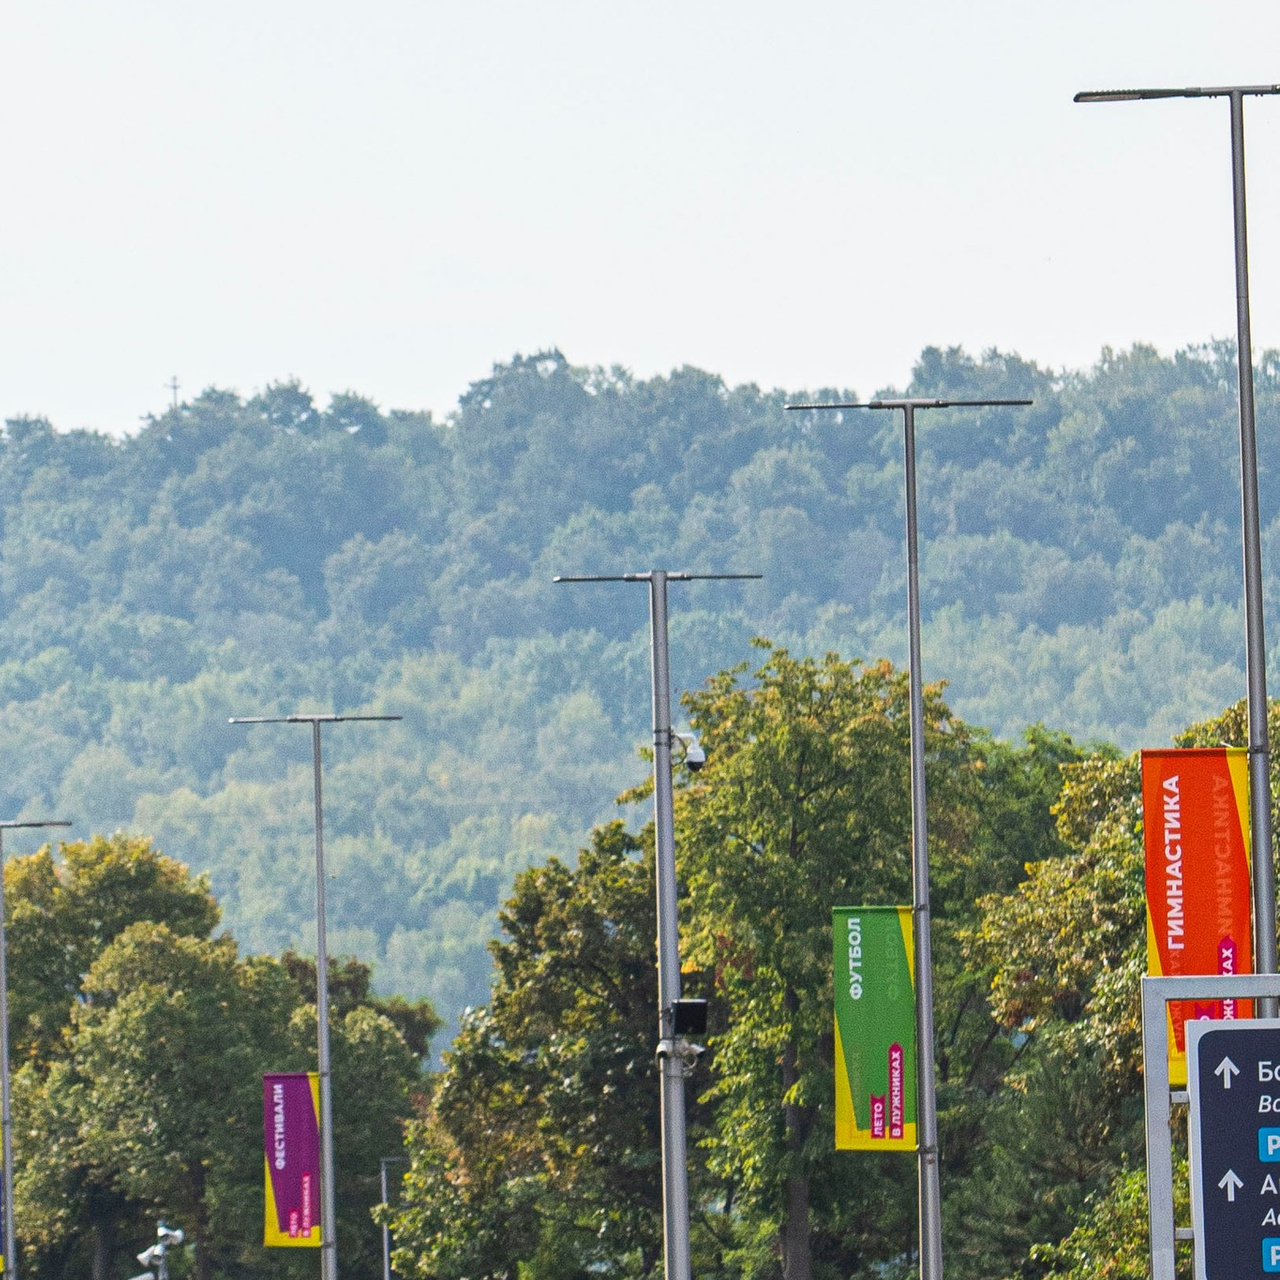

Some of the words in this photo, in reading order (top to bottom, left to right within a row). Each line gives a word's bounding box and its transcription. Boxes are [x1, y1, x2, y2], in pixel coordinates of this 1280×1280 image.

[1162, 774, 1184, 950] ГИМНАСТИКА
[848, 917, 863, 1000] ФУТБОЛ
[273, 1084, 286, 1170] ФЕСТИВАЛИ
[874, 1102, 883, 1136] ЛЕТО
[892, 1050, 901, 1125] ЛУЖНИКАХ
[892, 1128, 901, 1137] В
